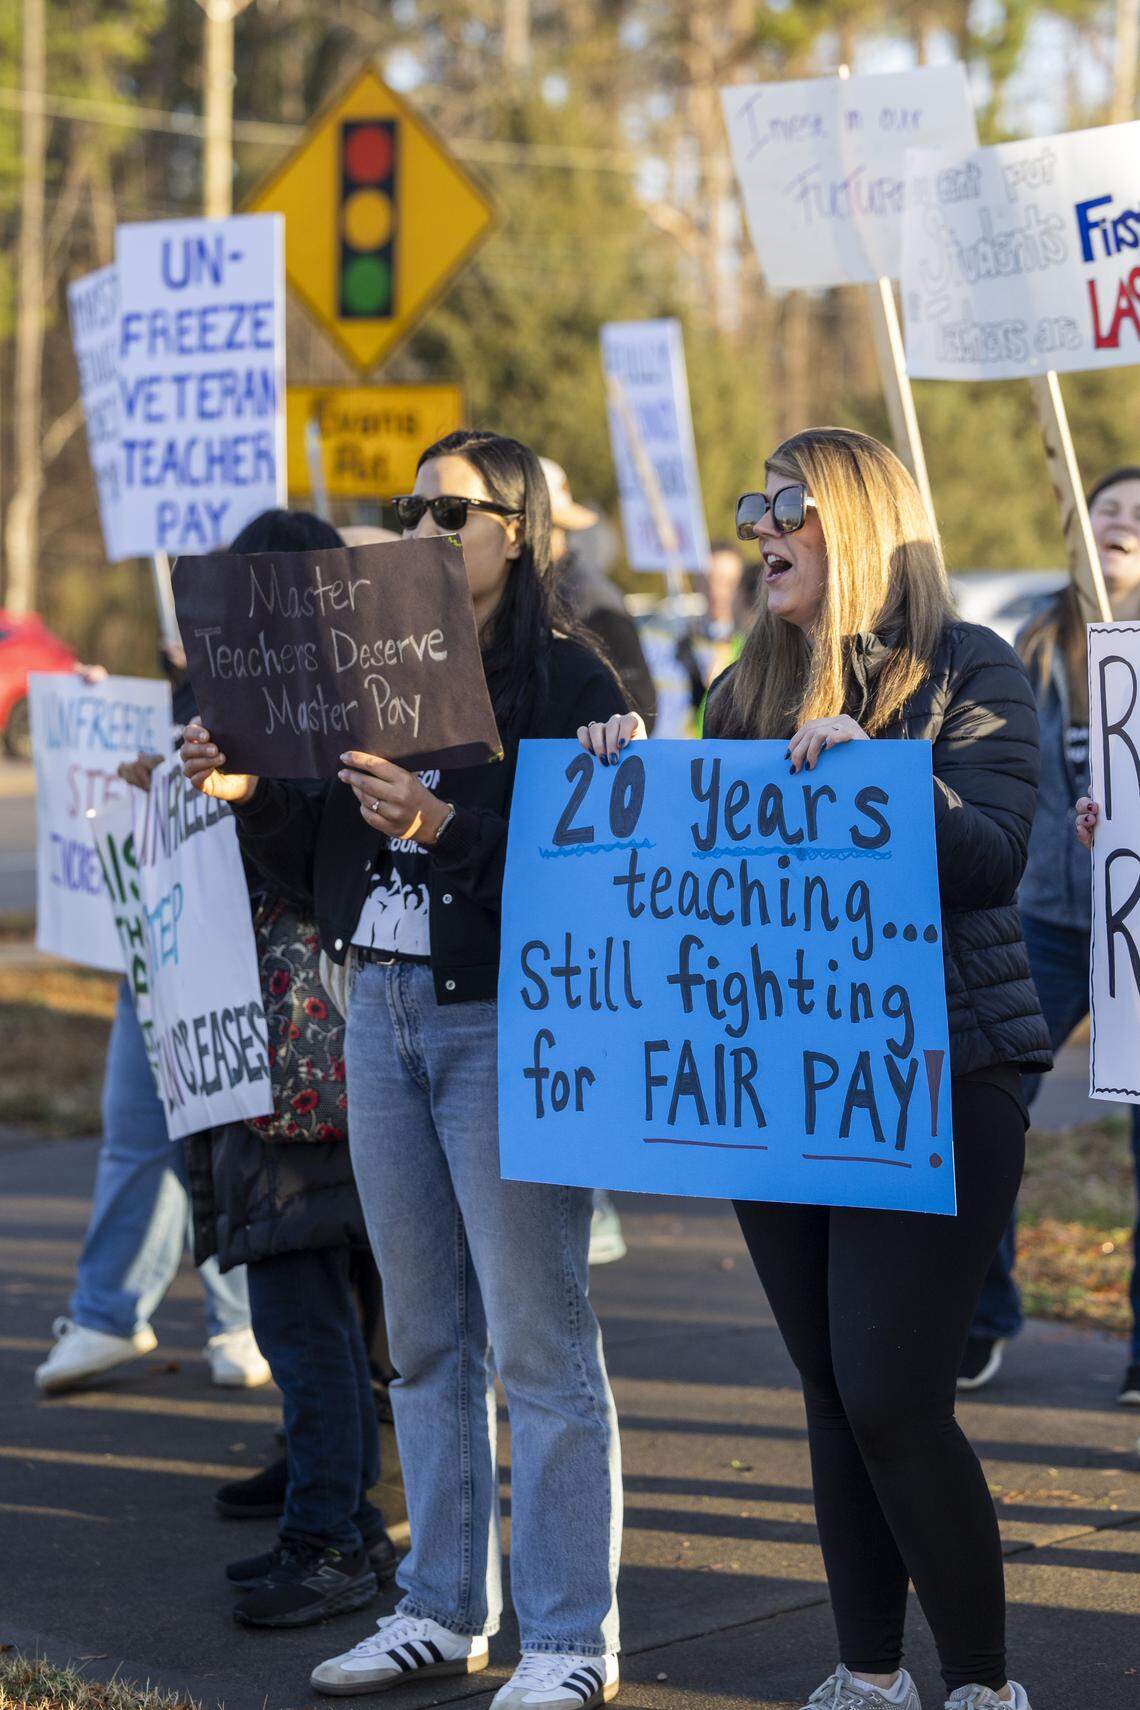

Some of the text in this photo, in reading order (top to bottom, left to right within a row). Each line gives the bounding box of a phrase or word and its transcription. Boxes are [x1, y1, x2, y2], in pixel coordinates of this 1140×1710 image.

[1075, 194, 1140, 262] Firs
[161, 235, 244, 290] UN-
[121, 301, 275, 357] FREEZE
[118, 368, 277, 422] VETERAN
[121, 432, 277, 487] TEACHER
[157, 499, 231, 547] PAY
[248, 563, 371, 618] Master
[194, 626, 448, 680] Teachers Deserve
[262, 673, 422, 738] Master Pay
[552, 752, 646, 846] 20
[612, 847, 939, 962] teaching...
[519, 931, 916, 1060] Still fighting
[522, 1027, 946, 1170] for FAIR PAY!
